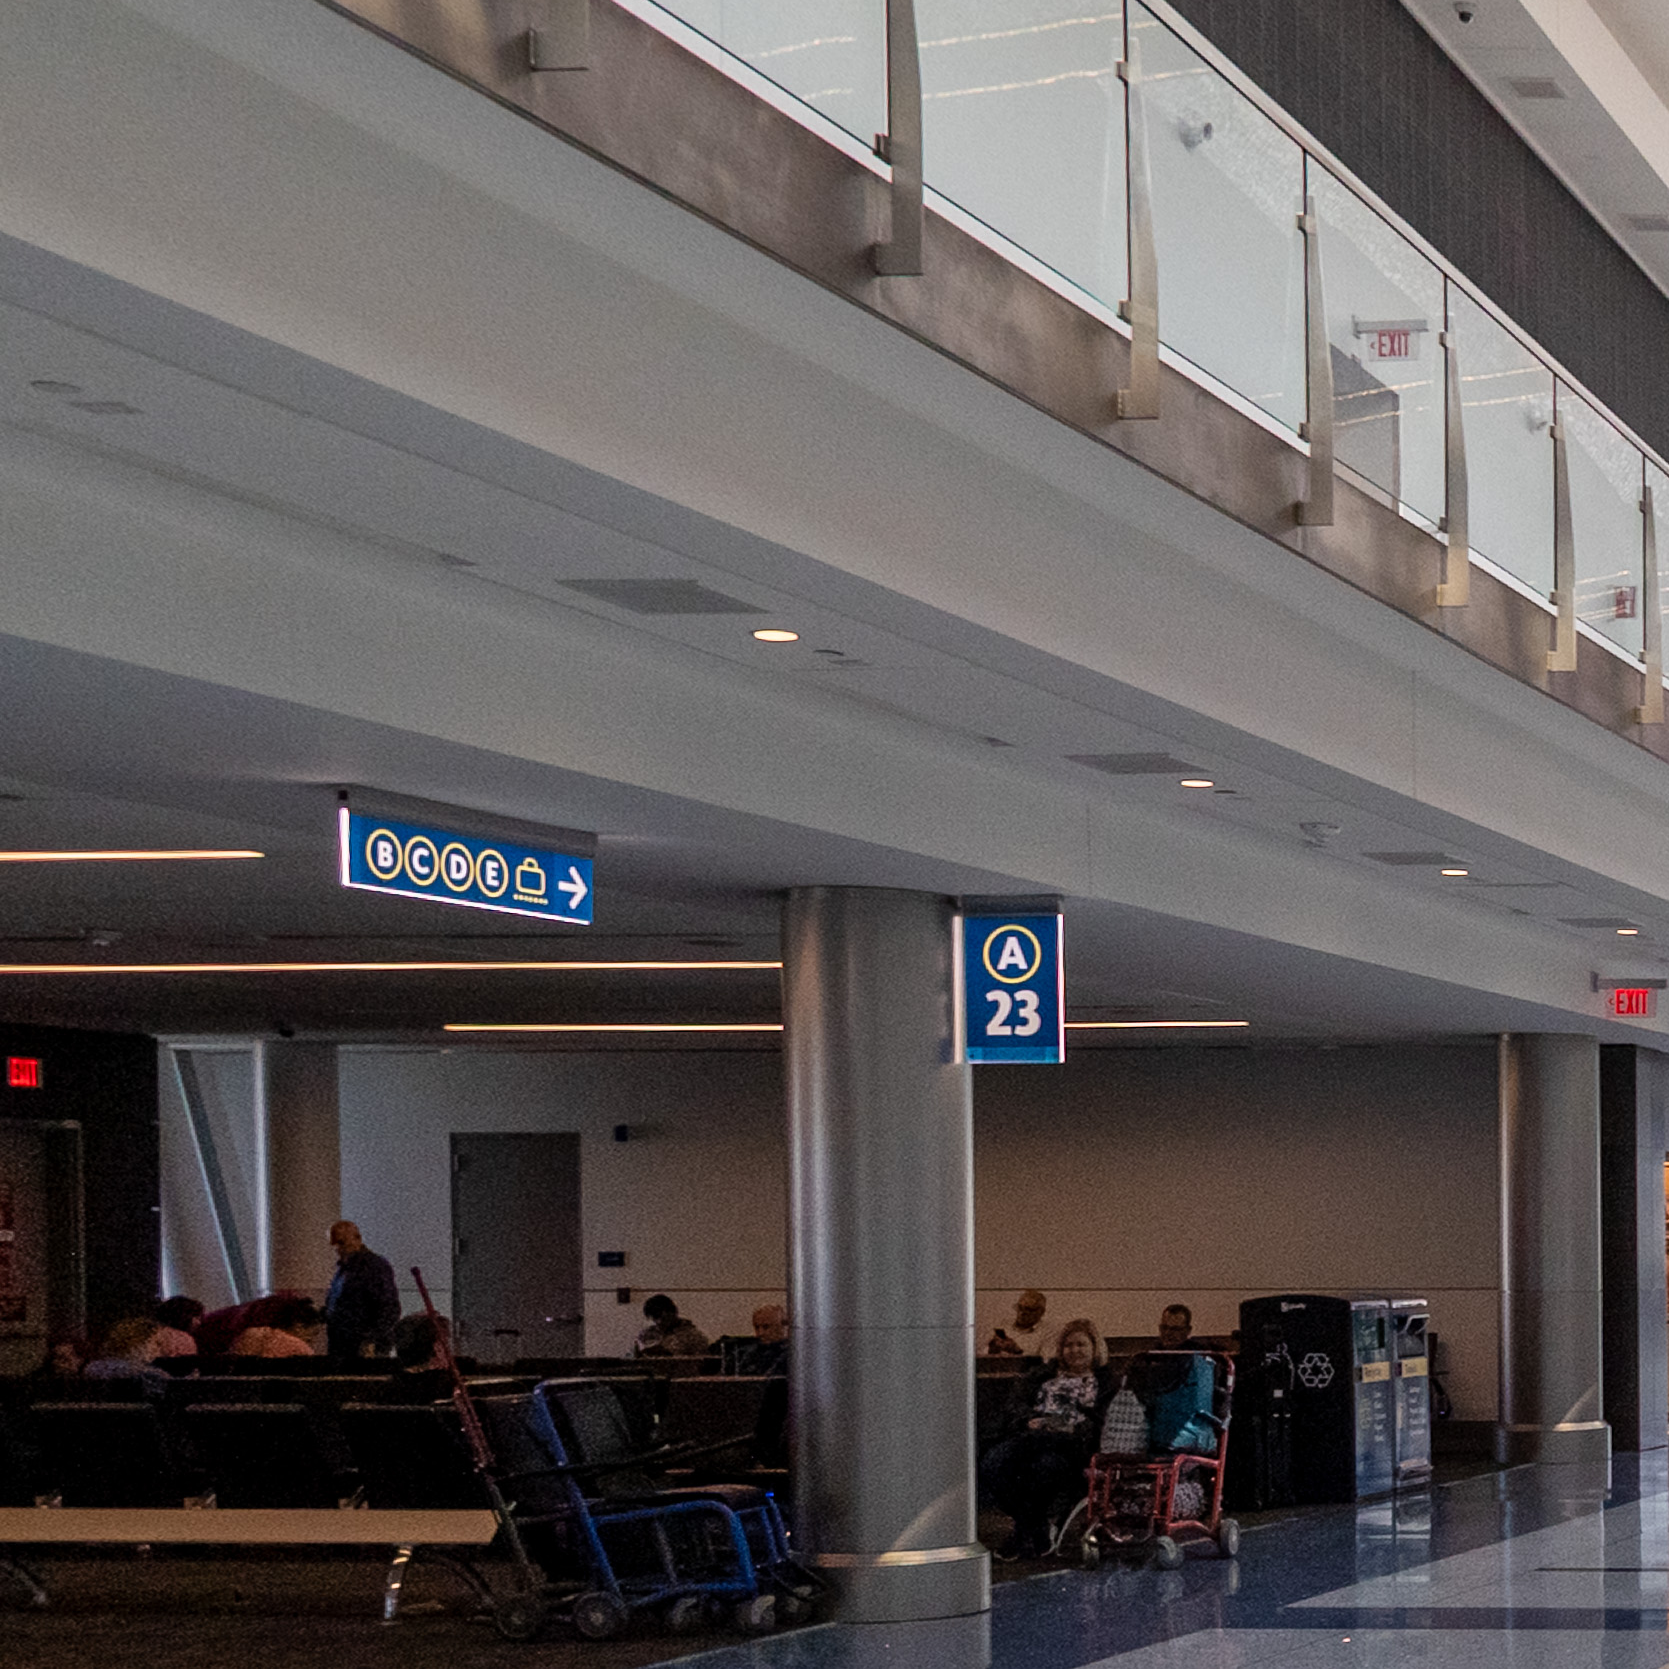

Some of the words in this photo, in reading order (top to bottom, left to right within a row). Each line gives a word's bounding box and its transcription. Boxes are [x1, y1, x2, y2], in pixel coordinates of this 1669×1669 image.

[1378, 330, 1409, 358] EXIT
[376, 841, 394, 868] B
[412, 847, 431, 875] C
[449, 853, 468, 880] D
[485, 860, 500, 887] E
[997, 936, 1028, 970] A
[985, 989, 1042, 1037] 23
[1615, 988, 1648, 1015] EXIT
